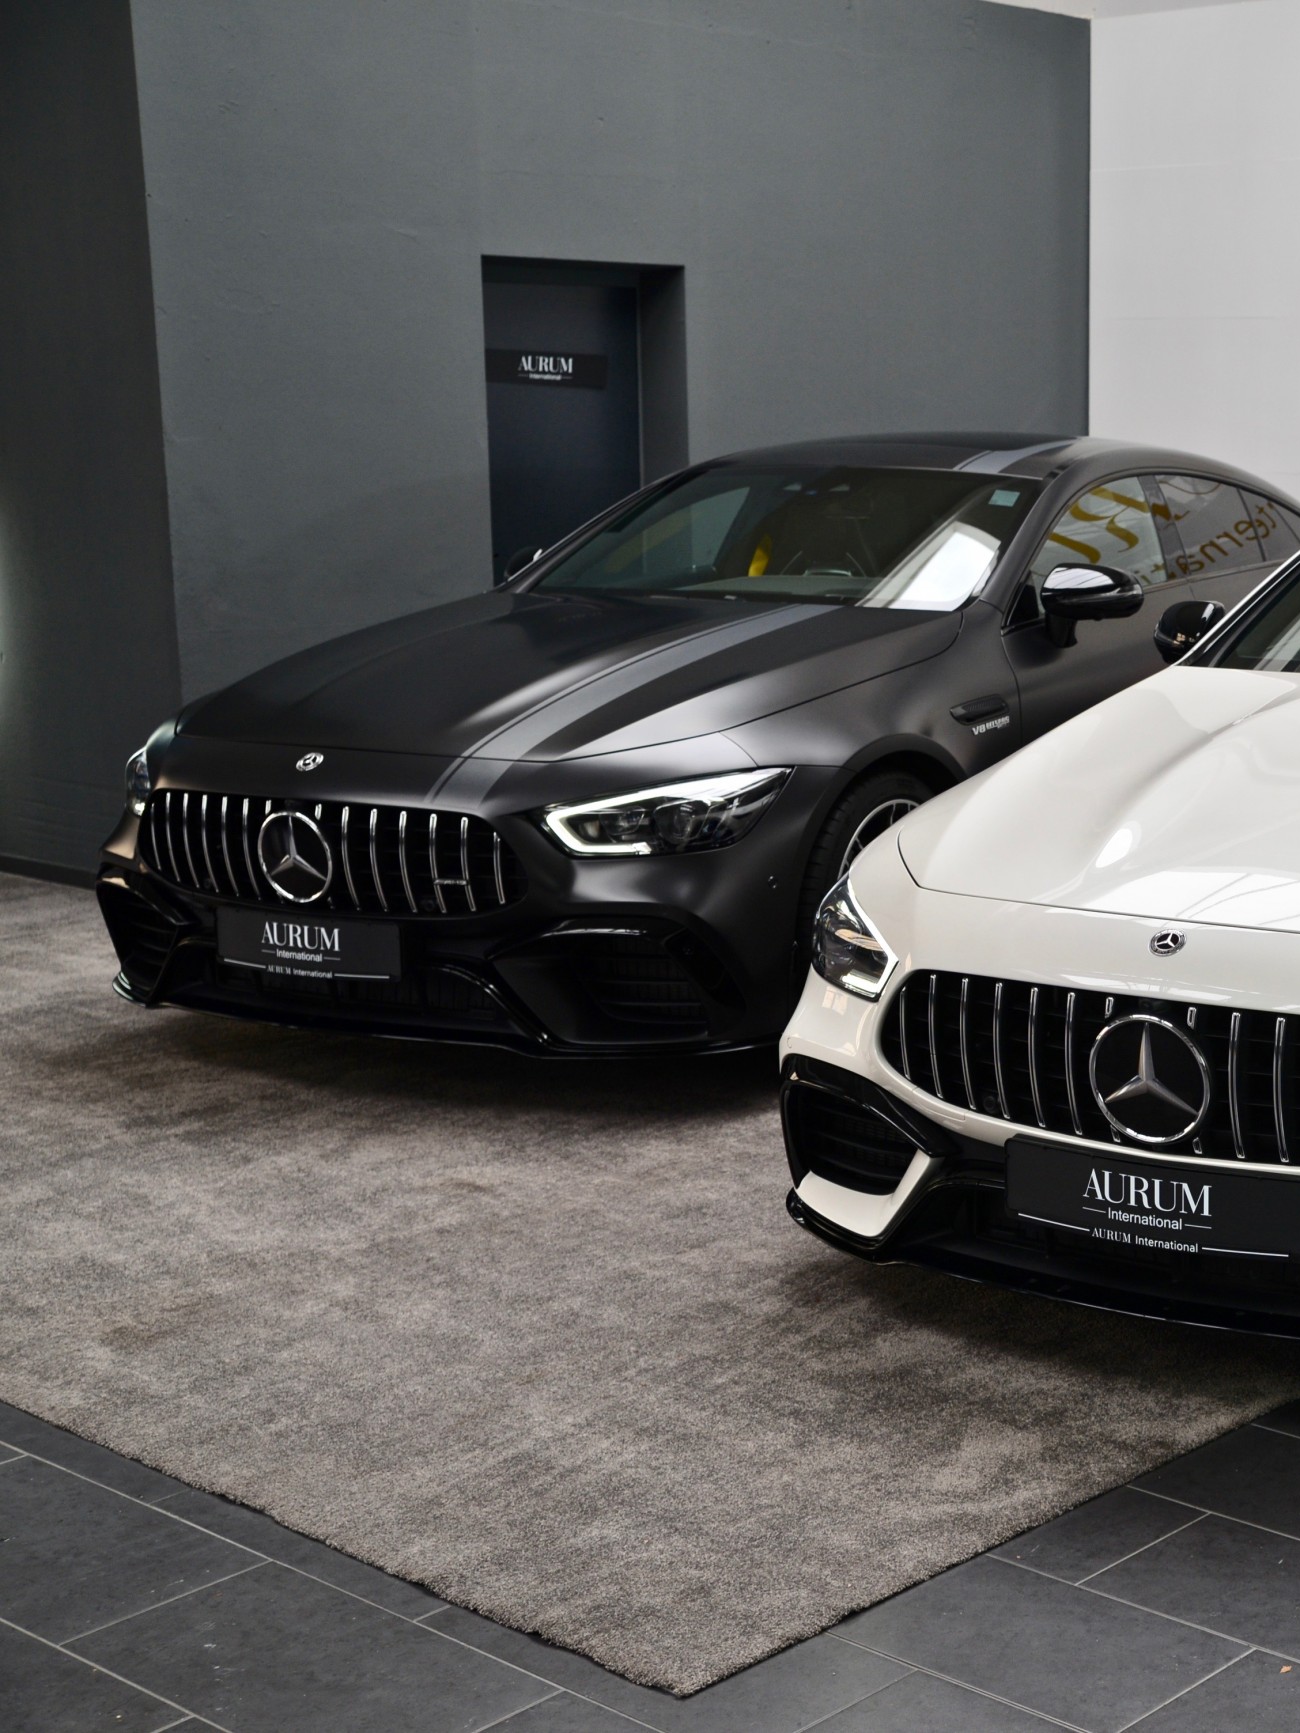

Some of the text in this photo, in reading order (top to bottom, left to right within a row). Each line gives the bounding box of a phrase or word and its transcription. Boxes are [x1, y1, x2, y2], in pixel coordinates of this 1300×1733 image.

[518, 355, 573, 373] AURUM
[261, 921, 341, 952] AURUM
[276, 949, 323, 962] International
[266, 965, 333, 979] AURUM International
[1083, 1168, 1212, 1216] AURUM
[1107, 1207, 1183, 1231] International
[1092, 1227, 1199, 1253] AURUM International
